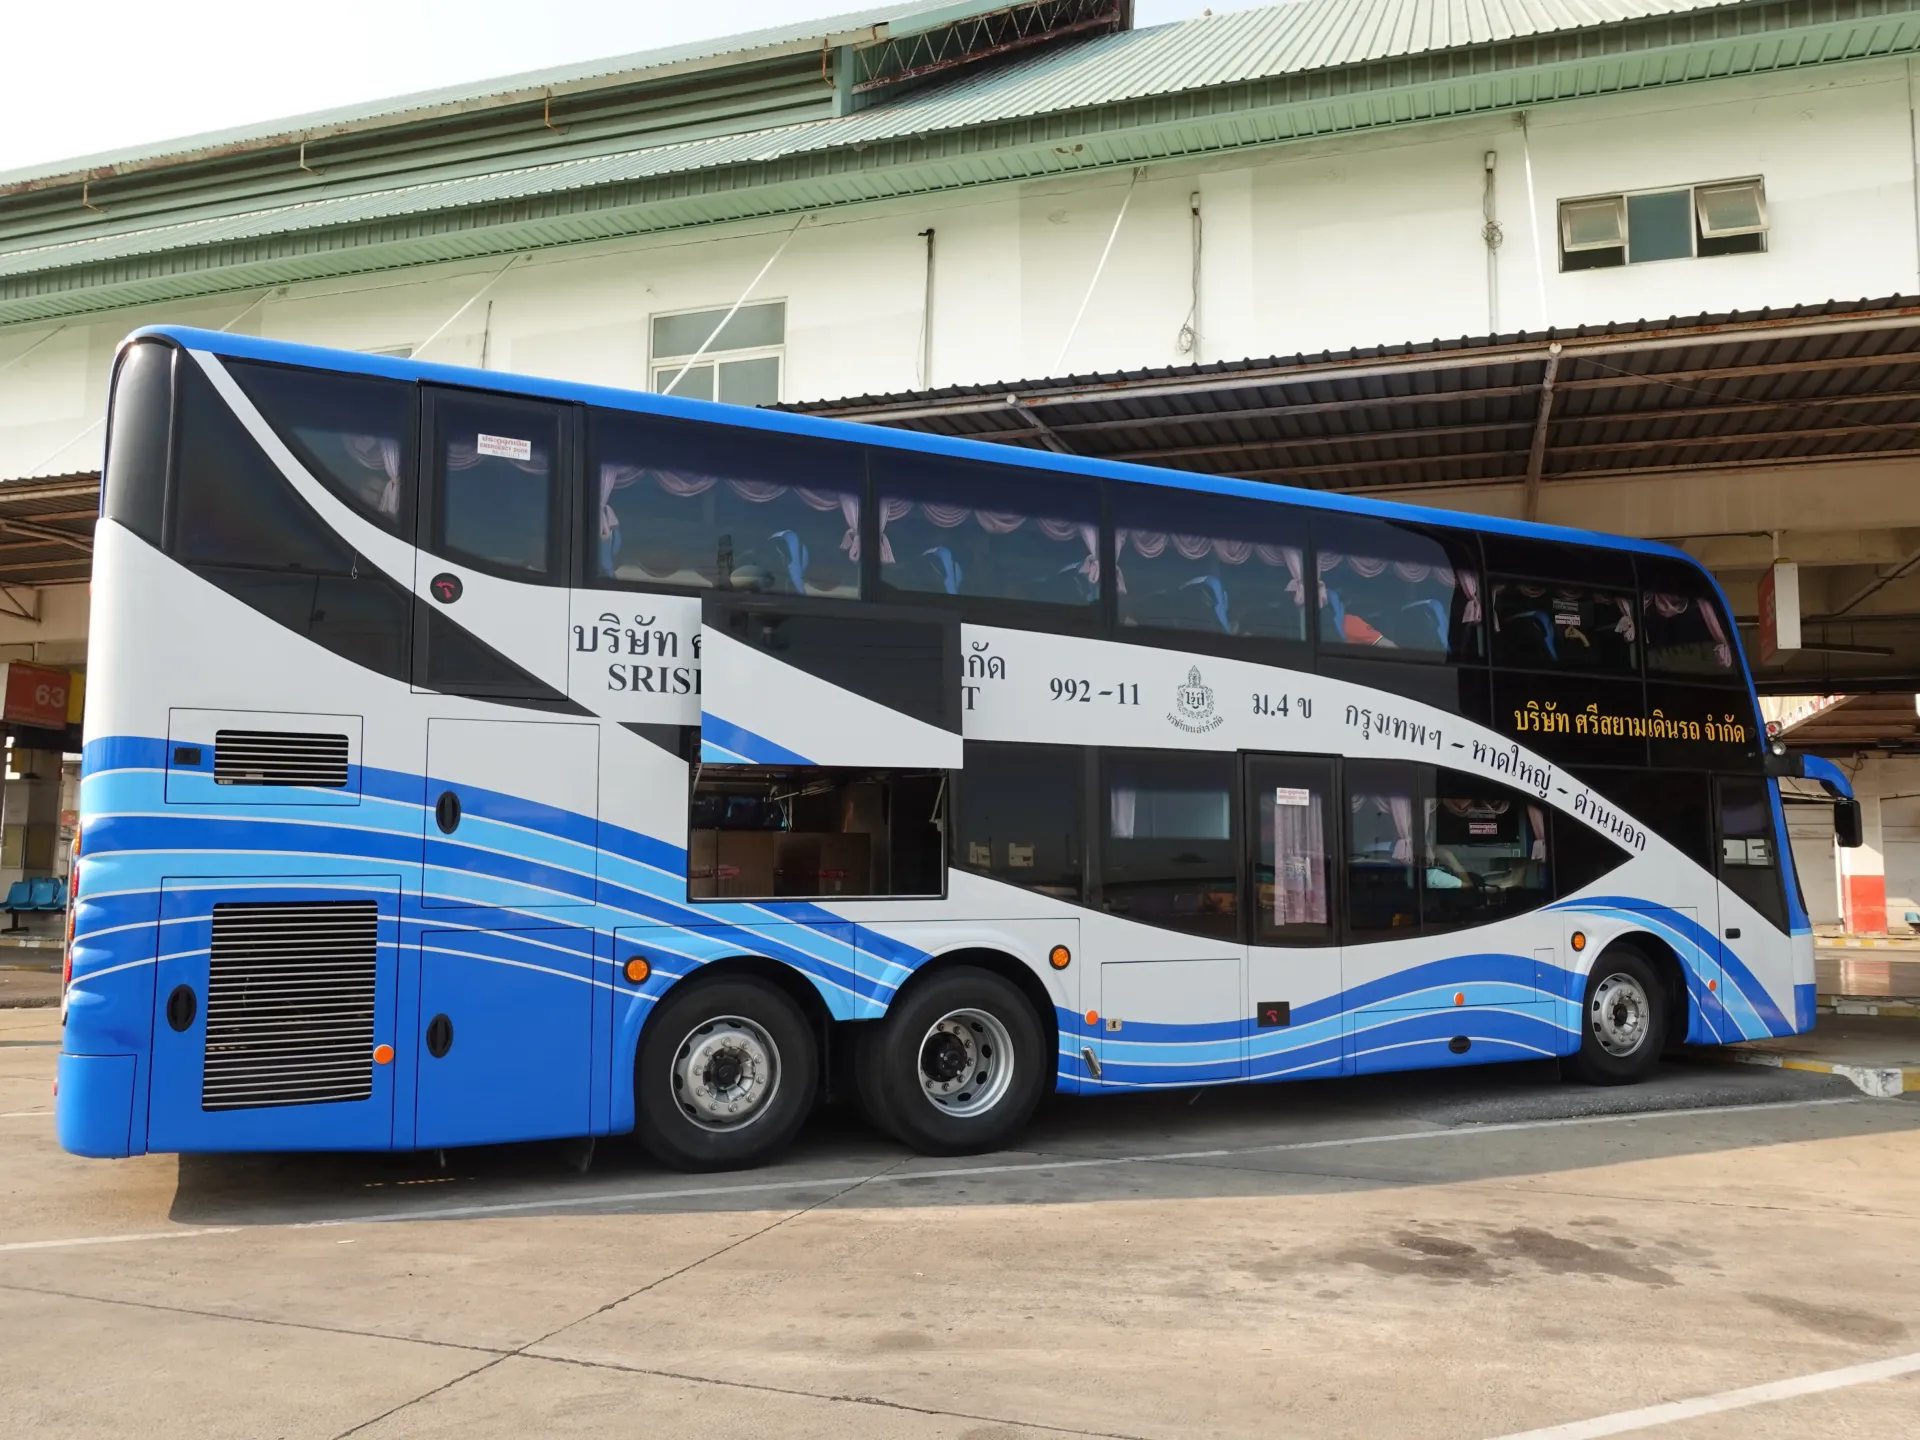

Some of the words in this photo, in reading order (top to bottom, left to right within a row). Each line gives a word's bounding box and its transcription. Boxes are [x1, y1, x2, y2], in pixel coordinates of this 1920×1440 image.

[573, 612, 678, 658] บริษัท
[35, 684, 65, 708] 63
[1514, 700, 1570, 733] บริษัท
[1575, 702, 1701, 740] ศรีสยามเดินรถ
[1704, 713, 1746, 743] จำกัด
[1345, 705, 1442, 751] กรุงเทพฯ
[1472, 739, 1551, 798] หาดใหญ่
[1574, 788, 1647, 851] ด่านนอก
